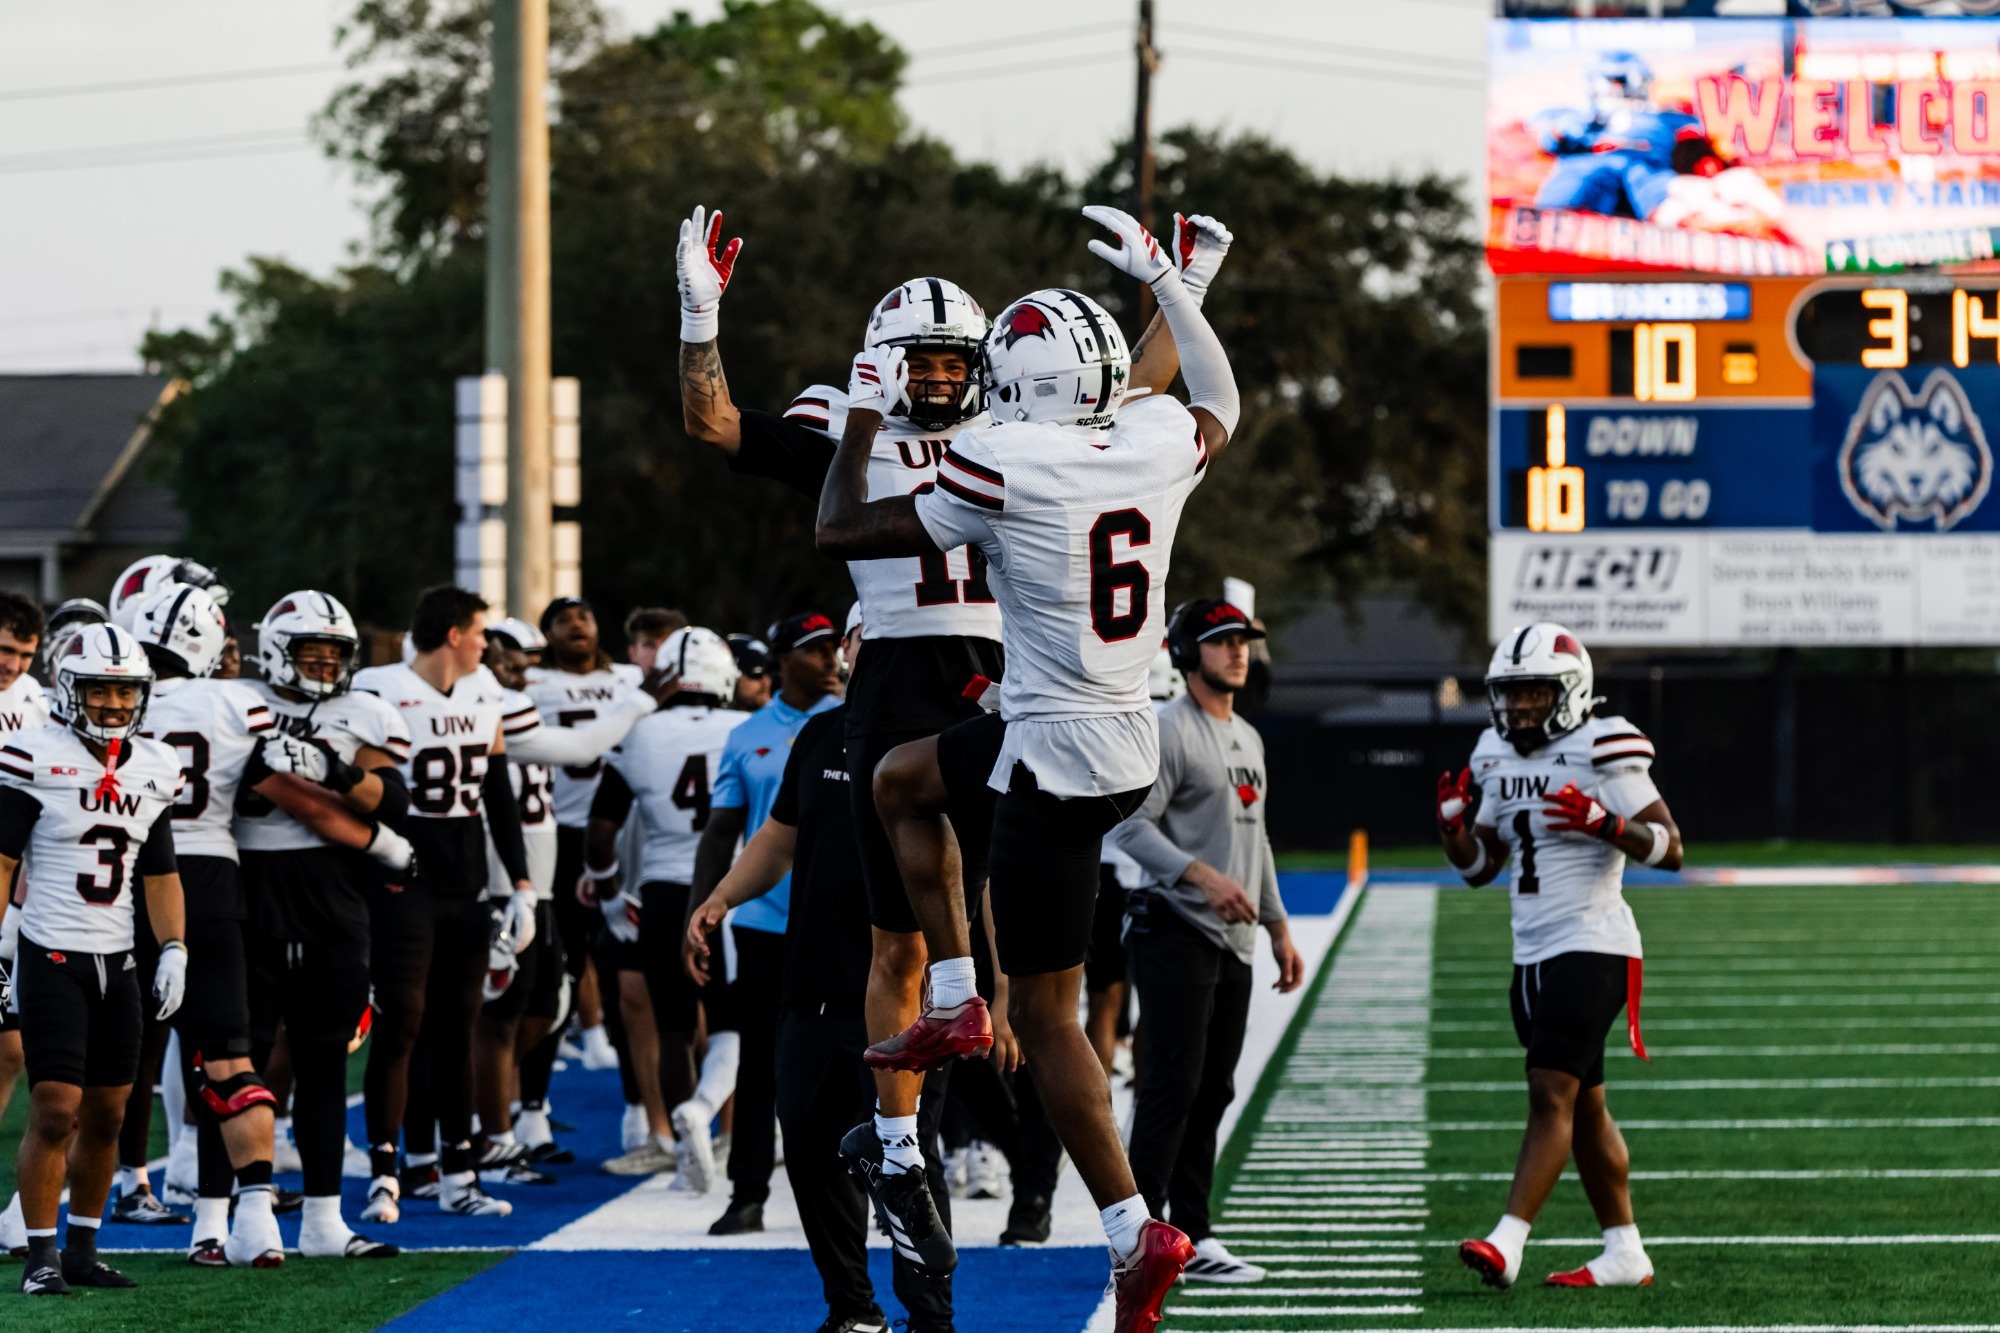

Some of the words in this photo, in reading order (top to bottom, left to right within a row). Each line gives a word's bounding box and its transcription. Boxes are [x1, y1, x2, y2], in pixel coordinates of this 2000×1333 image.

[1634, 322, 1696, 401] 10
[1075, 413, 1113, 426] schutt
[1547, 403, 1566, 468] 1
[1586, 415, 1699, 457] DOWN
[1527, 466, 1586, 532] 10
[1605, 479, 1650, 520] TO
[1658, 479, 1711, 520] GO
[1089, 507, 1151, 643] 6
[429, 716, 476, 736] UIW
[79, 788, 141, 817] UIW
[410, 743, 488, 816] 85
[671, 754, 711, 831] 4
[823, 769, 842, 780] THE
[1501, 776, 1549, 800] UIW
[76, 824, 129, 906] 3
[1513, 809, 1539, 894] 1
